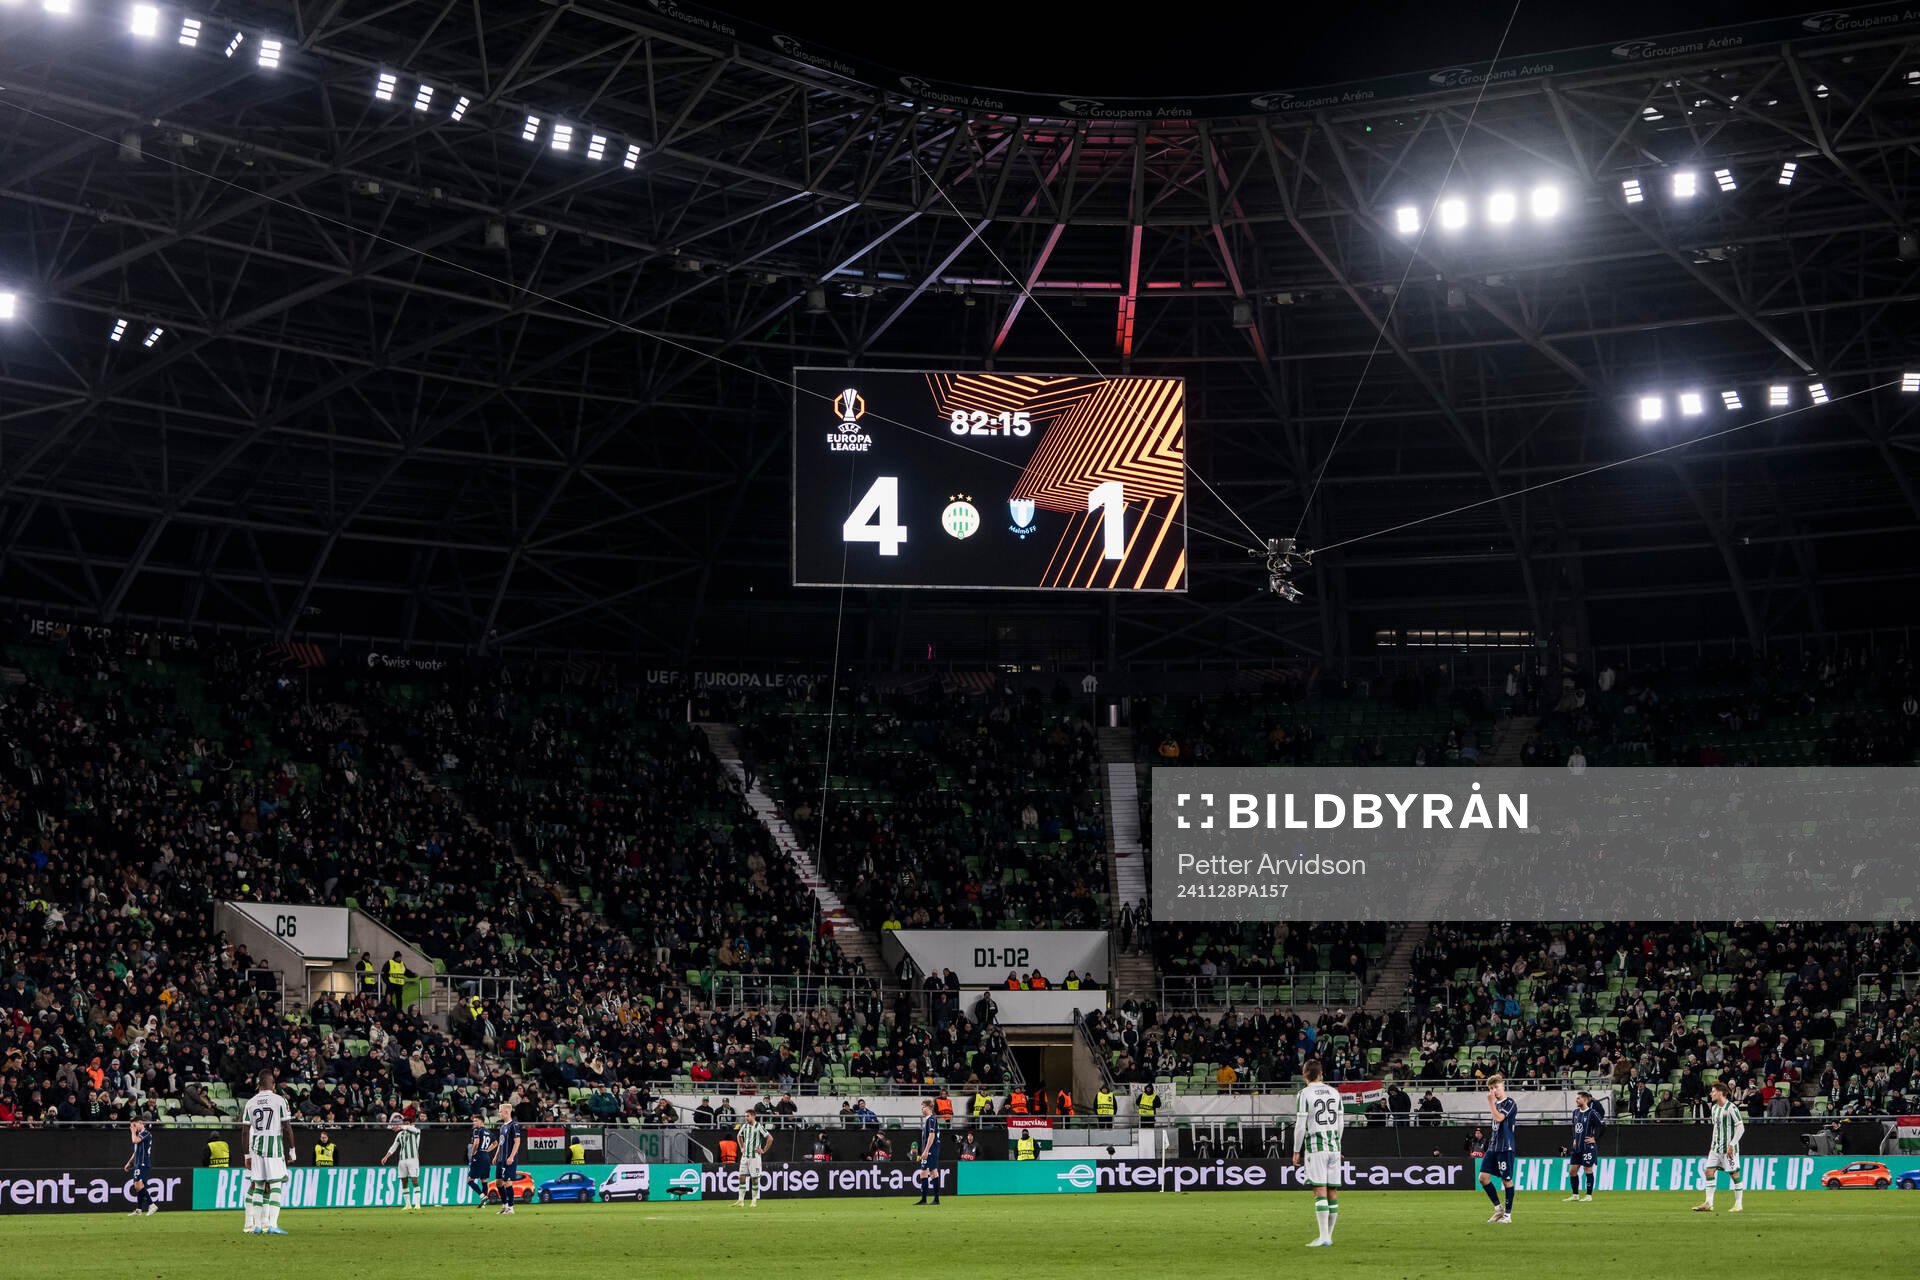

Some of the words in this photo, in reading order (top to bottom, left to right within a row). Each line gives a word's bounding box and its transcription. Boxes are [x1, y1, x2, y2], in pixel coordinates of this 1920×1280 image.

[668, 6, 711, 29] Groupama
[1835, 13, 1899, 31] Groupama
[792, 46, 832, 69] Groupama
[1642, 42, 1704, 59] Groupama
[1458, 69, 1517, 86] Groupama
[919, 87, 969, 107] Groupama
[1281, 95, 1339, 112] Groupama
[1090, 105, 1153, 119] Groupama
[950, 410, 1032, 437] 82:15
[827, 434, 872, 443] EUROPA
[831, 443, 869, 451] LEAGUE
[842, 476, 908, 556] 4
[1088, 481, 1125, 559] 1
[276, 914, 297, 937] C6
[974, 947, 1029, 968] D1-D2
[253, 1107, 273, 1131] 27
[1314, 1098, 1337, 1125] 25
[481, 1135, 491, 1149] 19
[640, 1133, 659, 1157] C6
[828, 1164, 951, 1190] rent-a-cr
[1056, 1159, 1267, 1193] enterprise
[1501, 1158, 1554, 1191] ENT
[1625, 1158, 1663, 1191] THE
[1669, 1157, 1717, 1191] BES
[1729, 1157, 1779, 1191] INE
[1785, 1157, 1815, 1191] UP
[279, 1168, 320, 1207] ROM
[326, 1168, 359, 1206] THE
[412, 1167, 452, 1205] INE
